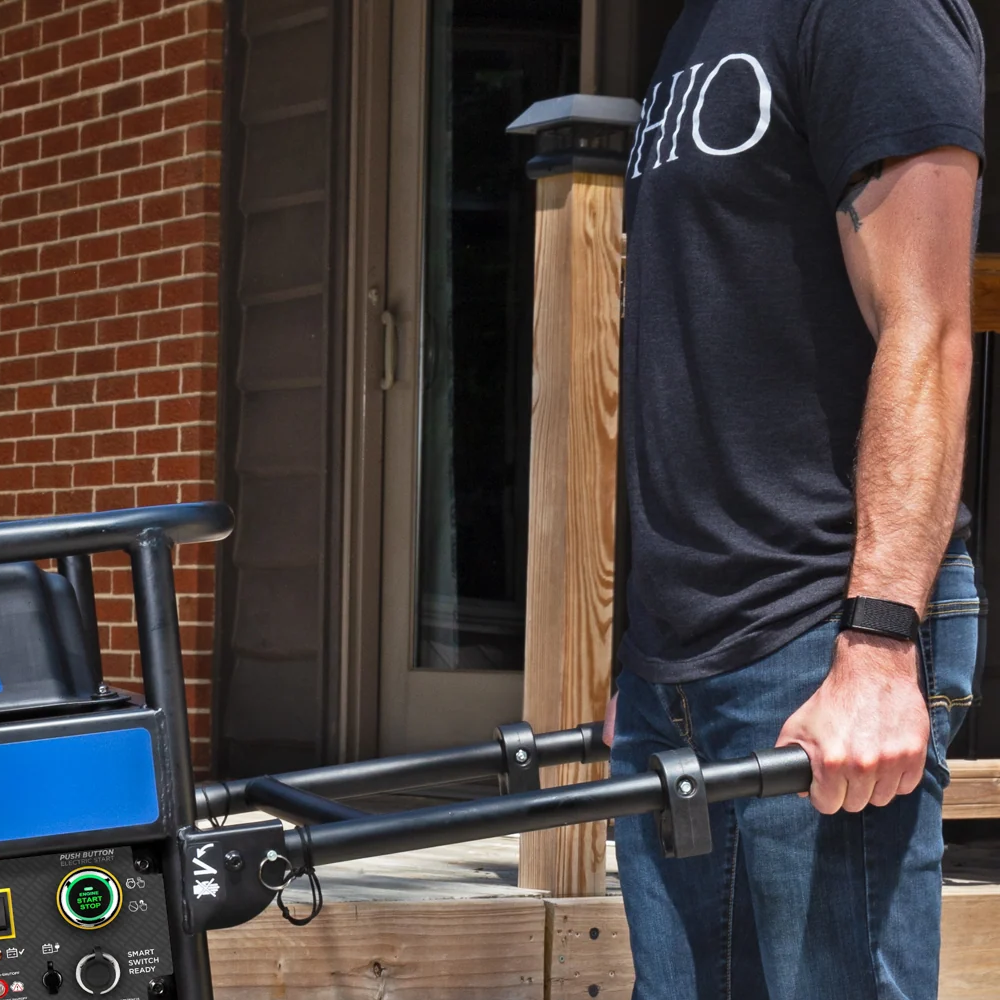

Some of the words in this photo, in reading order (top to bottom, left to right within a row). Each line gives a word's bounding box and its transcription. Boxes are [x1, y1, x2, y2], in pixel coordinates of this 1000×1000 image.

[60, 852, 80, 860] PUSH
[82, 849, 114, 858] BUTTON
[60, 858, 92, 866] ELECTRIC
[77, 896, 102, 904] START
[128, 949, 154, 957] SMART
[128, 957, 159, 966] SWITCH
[129, 966, 156, 974] READY
